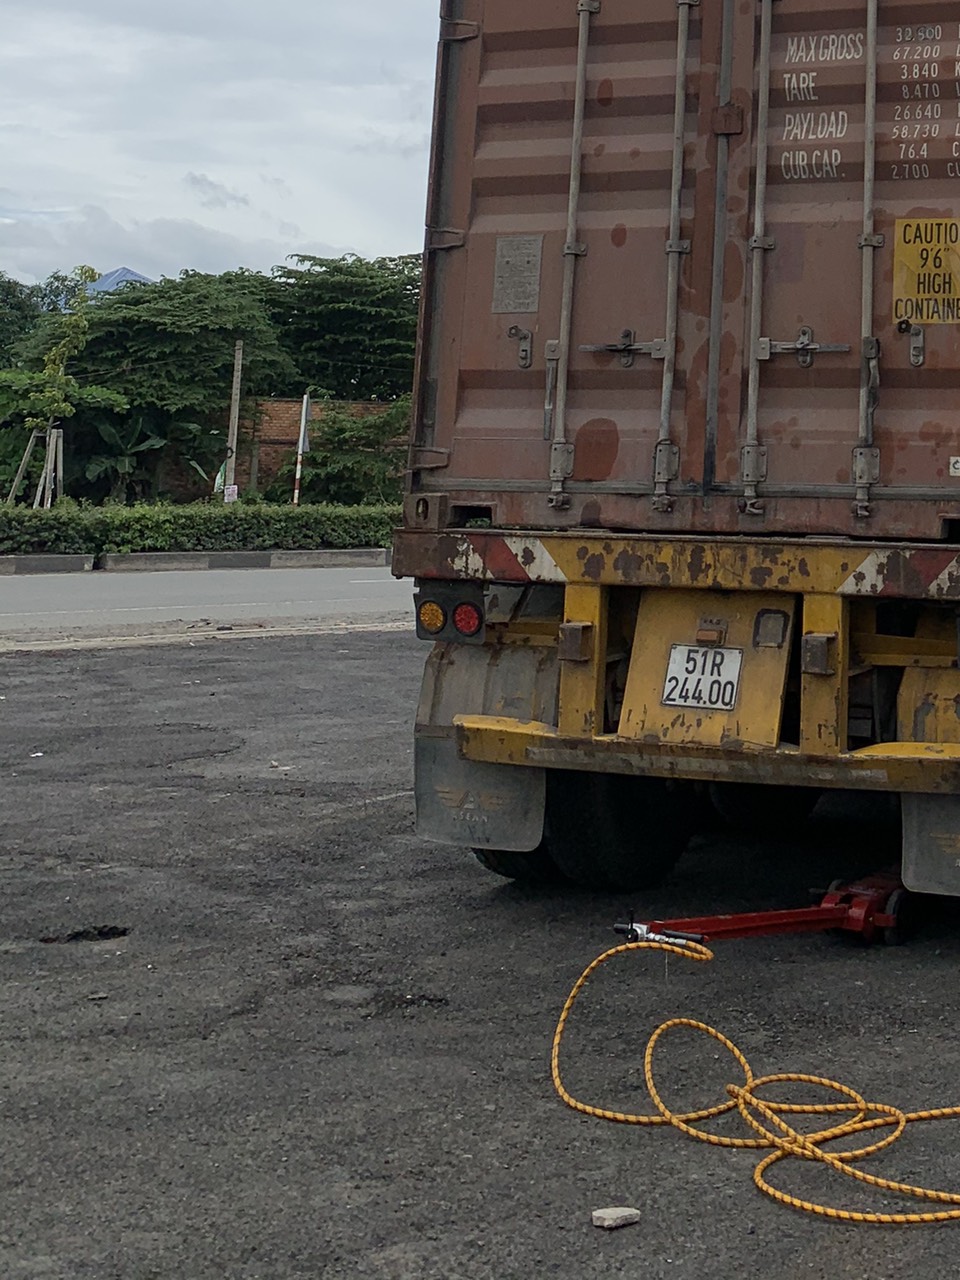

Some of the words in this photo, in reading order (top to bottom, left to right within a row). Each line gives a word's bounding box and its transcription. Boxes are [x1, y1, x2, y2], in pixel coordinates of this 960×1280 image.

[785, 37, 817, 63] MAX
[819, 33, 864, 61] GROSS
[893, 45, 940, 60] 67.200
[784, 72, 818, 101] TARE
[901, 62, 938, 79] 3.840
[902, 83, 940, 99] 8.470
[783, 111, 848, 140] PAYLOAD
[894, 103, 941, 120] 26.640
[892, 124, 940, 139] 58.730
[899, 143, 928, 159] 76.4
[891, 164, 930, 180] 2.700
[917, 272, 952, 294] HIGH
[685, 649, 725, 677] 51R
[663, 676, 735, 707] 244.00
